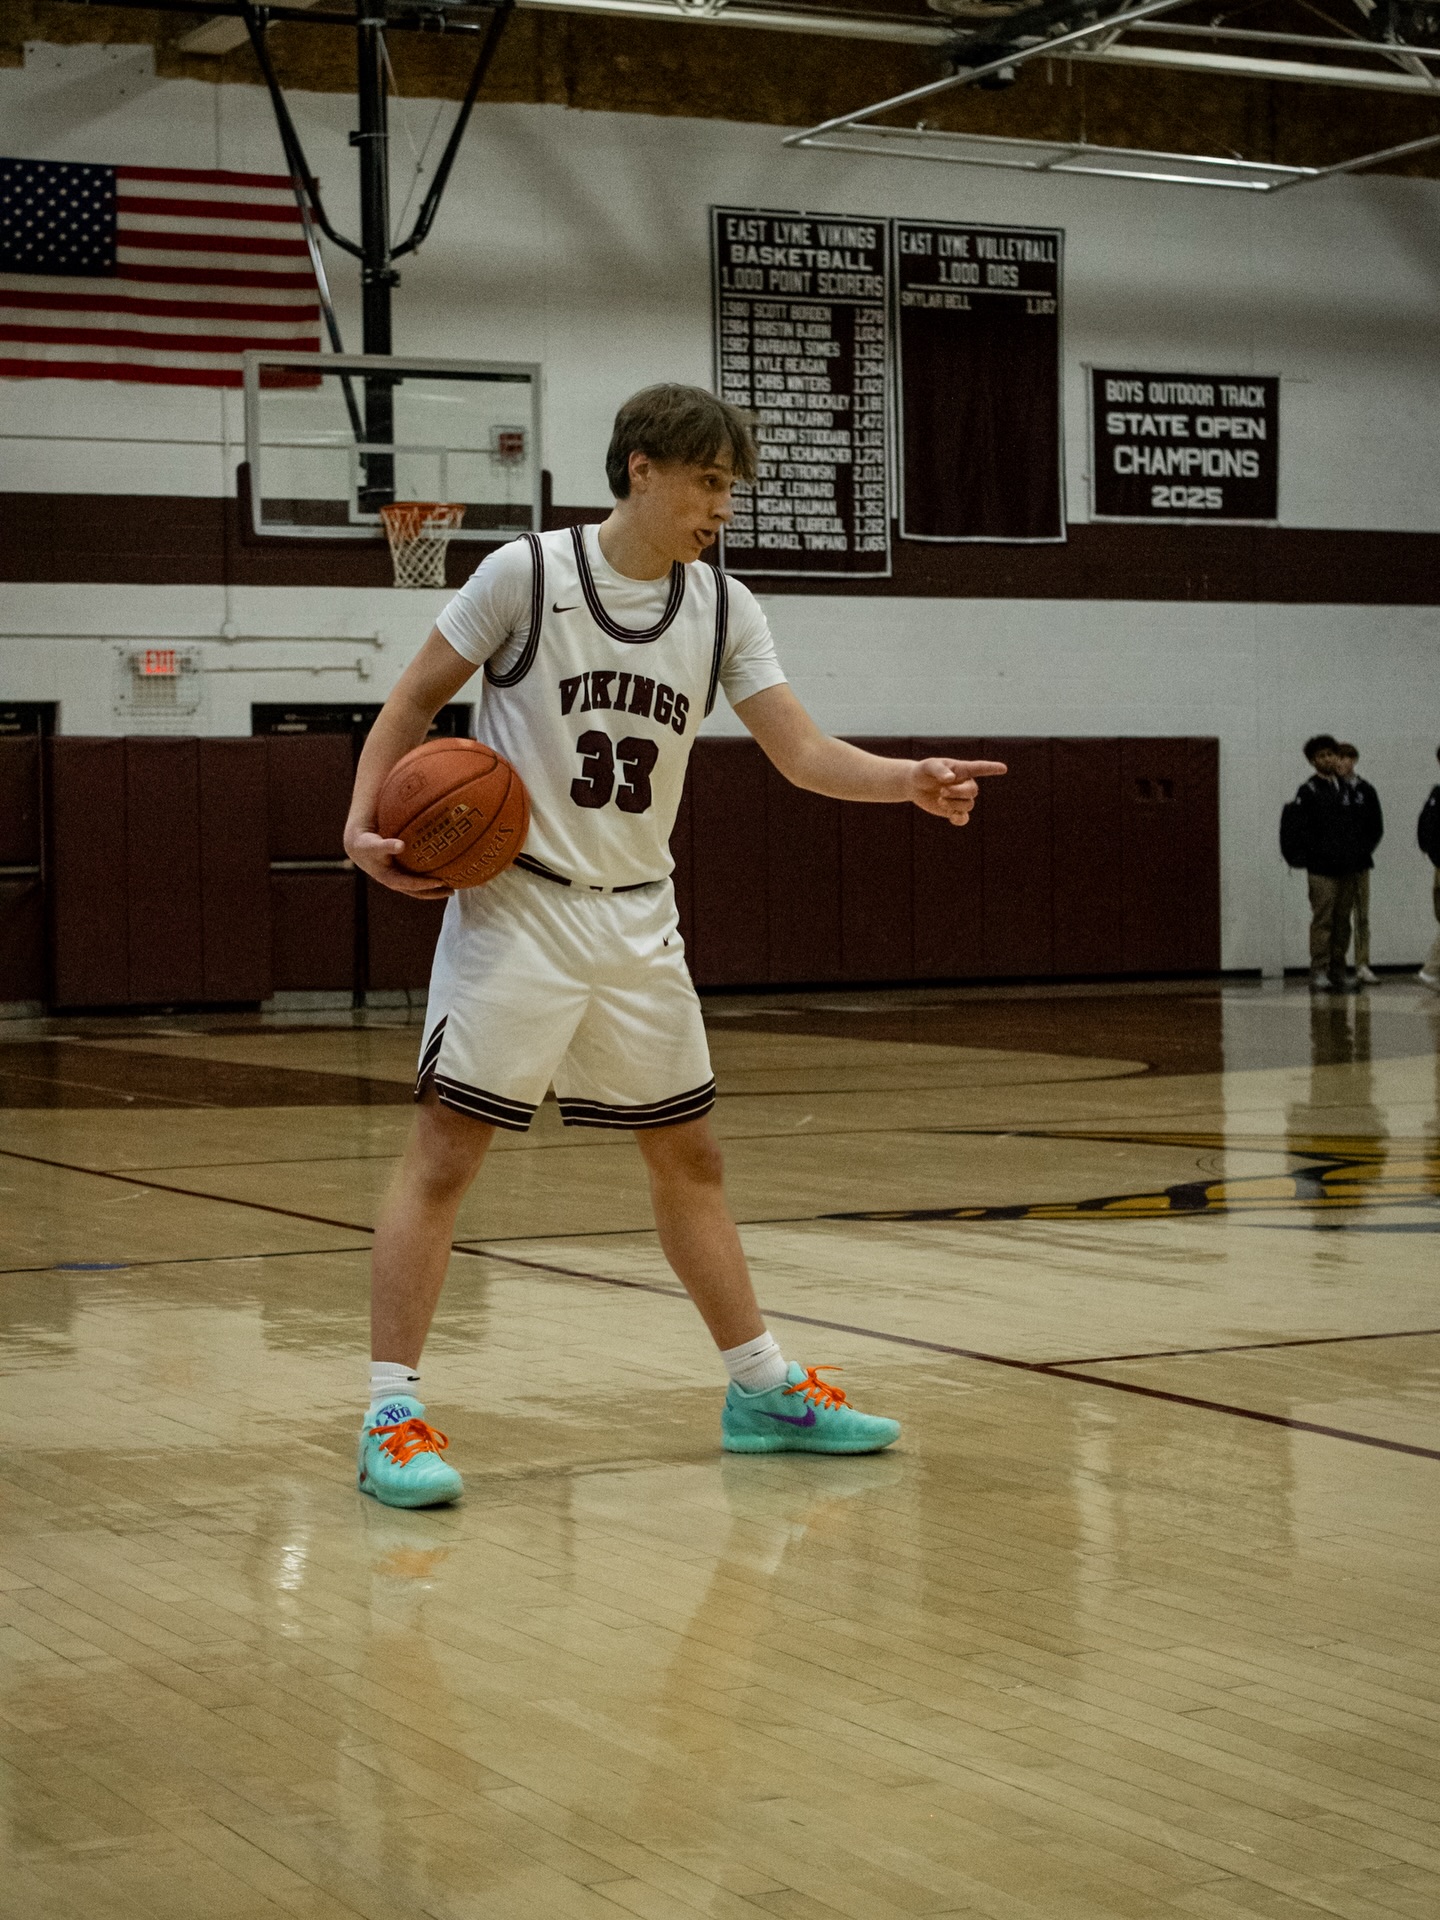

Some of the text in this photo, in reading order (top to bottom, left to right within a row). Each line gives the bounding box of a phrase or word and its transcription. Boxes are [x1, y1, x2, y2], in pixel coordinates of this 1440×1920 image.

[726, 218, 877, 250] EAST LYME VIKINGS
[730, 244, 874, 271] BASKETBALL
[900, 231, 1056, 264] EAST LYME VOLLEYBALL
[769, 269, 811, 294] POINT
[817, 272, 884, 298] SCORERS
[986, 263, 1020, 288] DIGS
[901, 291, 943, 309] SKYLAR
[944, 294, 973, 311] BELL
[753, 303, 787, 319] SCOTT
[789, 305, 833, 322] BORDEN
[753, 338, 803, 355] BARBARA
[753, 355, 784, 373] KYLE
[784, 357, 829, 374] REAGAN
[753, 373, 786, 391] CHRIS
[786, 375, 832, 392] WINTERS
[1105, 379, 1266, 408] BOYS OUTDOOR TRACK
[754, 391, 806, 408] ELIZABETH
[807, 393, 851, 411] BUCKLEY
[758, 409, 783, 425] JOHN
[1106, 412, 1267, 440] STATE OPEN
[756, 427, 797, 443] ALLISON
[790, 446, 853, 463] SCHUMACHER
[1113, 445, 1260, 478] CHAMPIONS
[778, 464, 837, 481] OSTROWSKI
[756, 481, 785, 497] LUKE
[786, 482, 835, 498] LEONARD
[1151, 485, 1223, 509] 2025
[756, 499, 793, 515] MEGAN
[756, 516, 795, 532] SOPHIE
[725, 532, 755, 548] 2025
[757, 533, 803, 550] MICHAEL
[803, 534, 848, 551] TIMPANO
[145, 649, 176, 673] EXIT
[559, 671, 690, 736] VIKINGS
[570, 729, 660, 814] 33
[415, 807, 484, 864] LEGACY
[446, 822, 514, 885] SPALDIN
